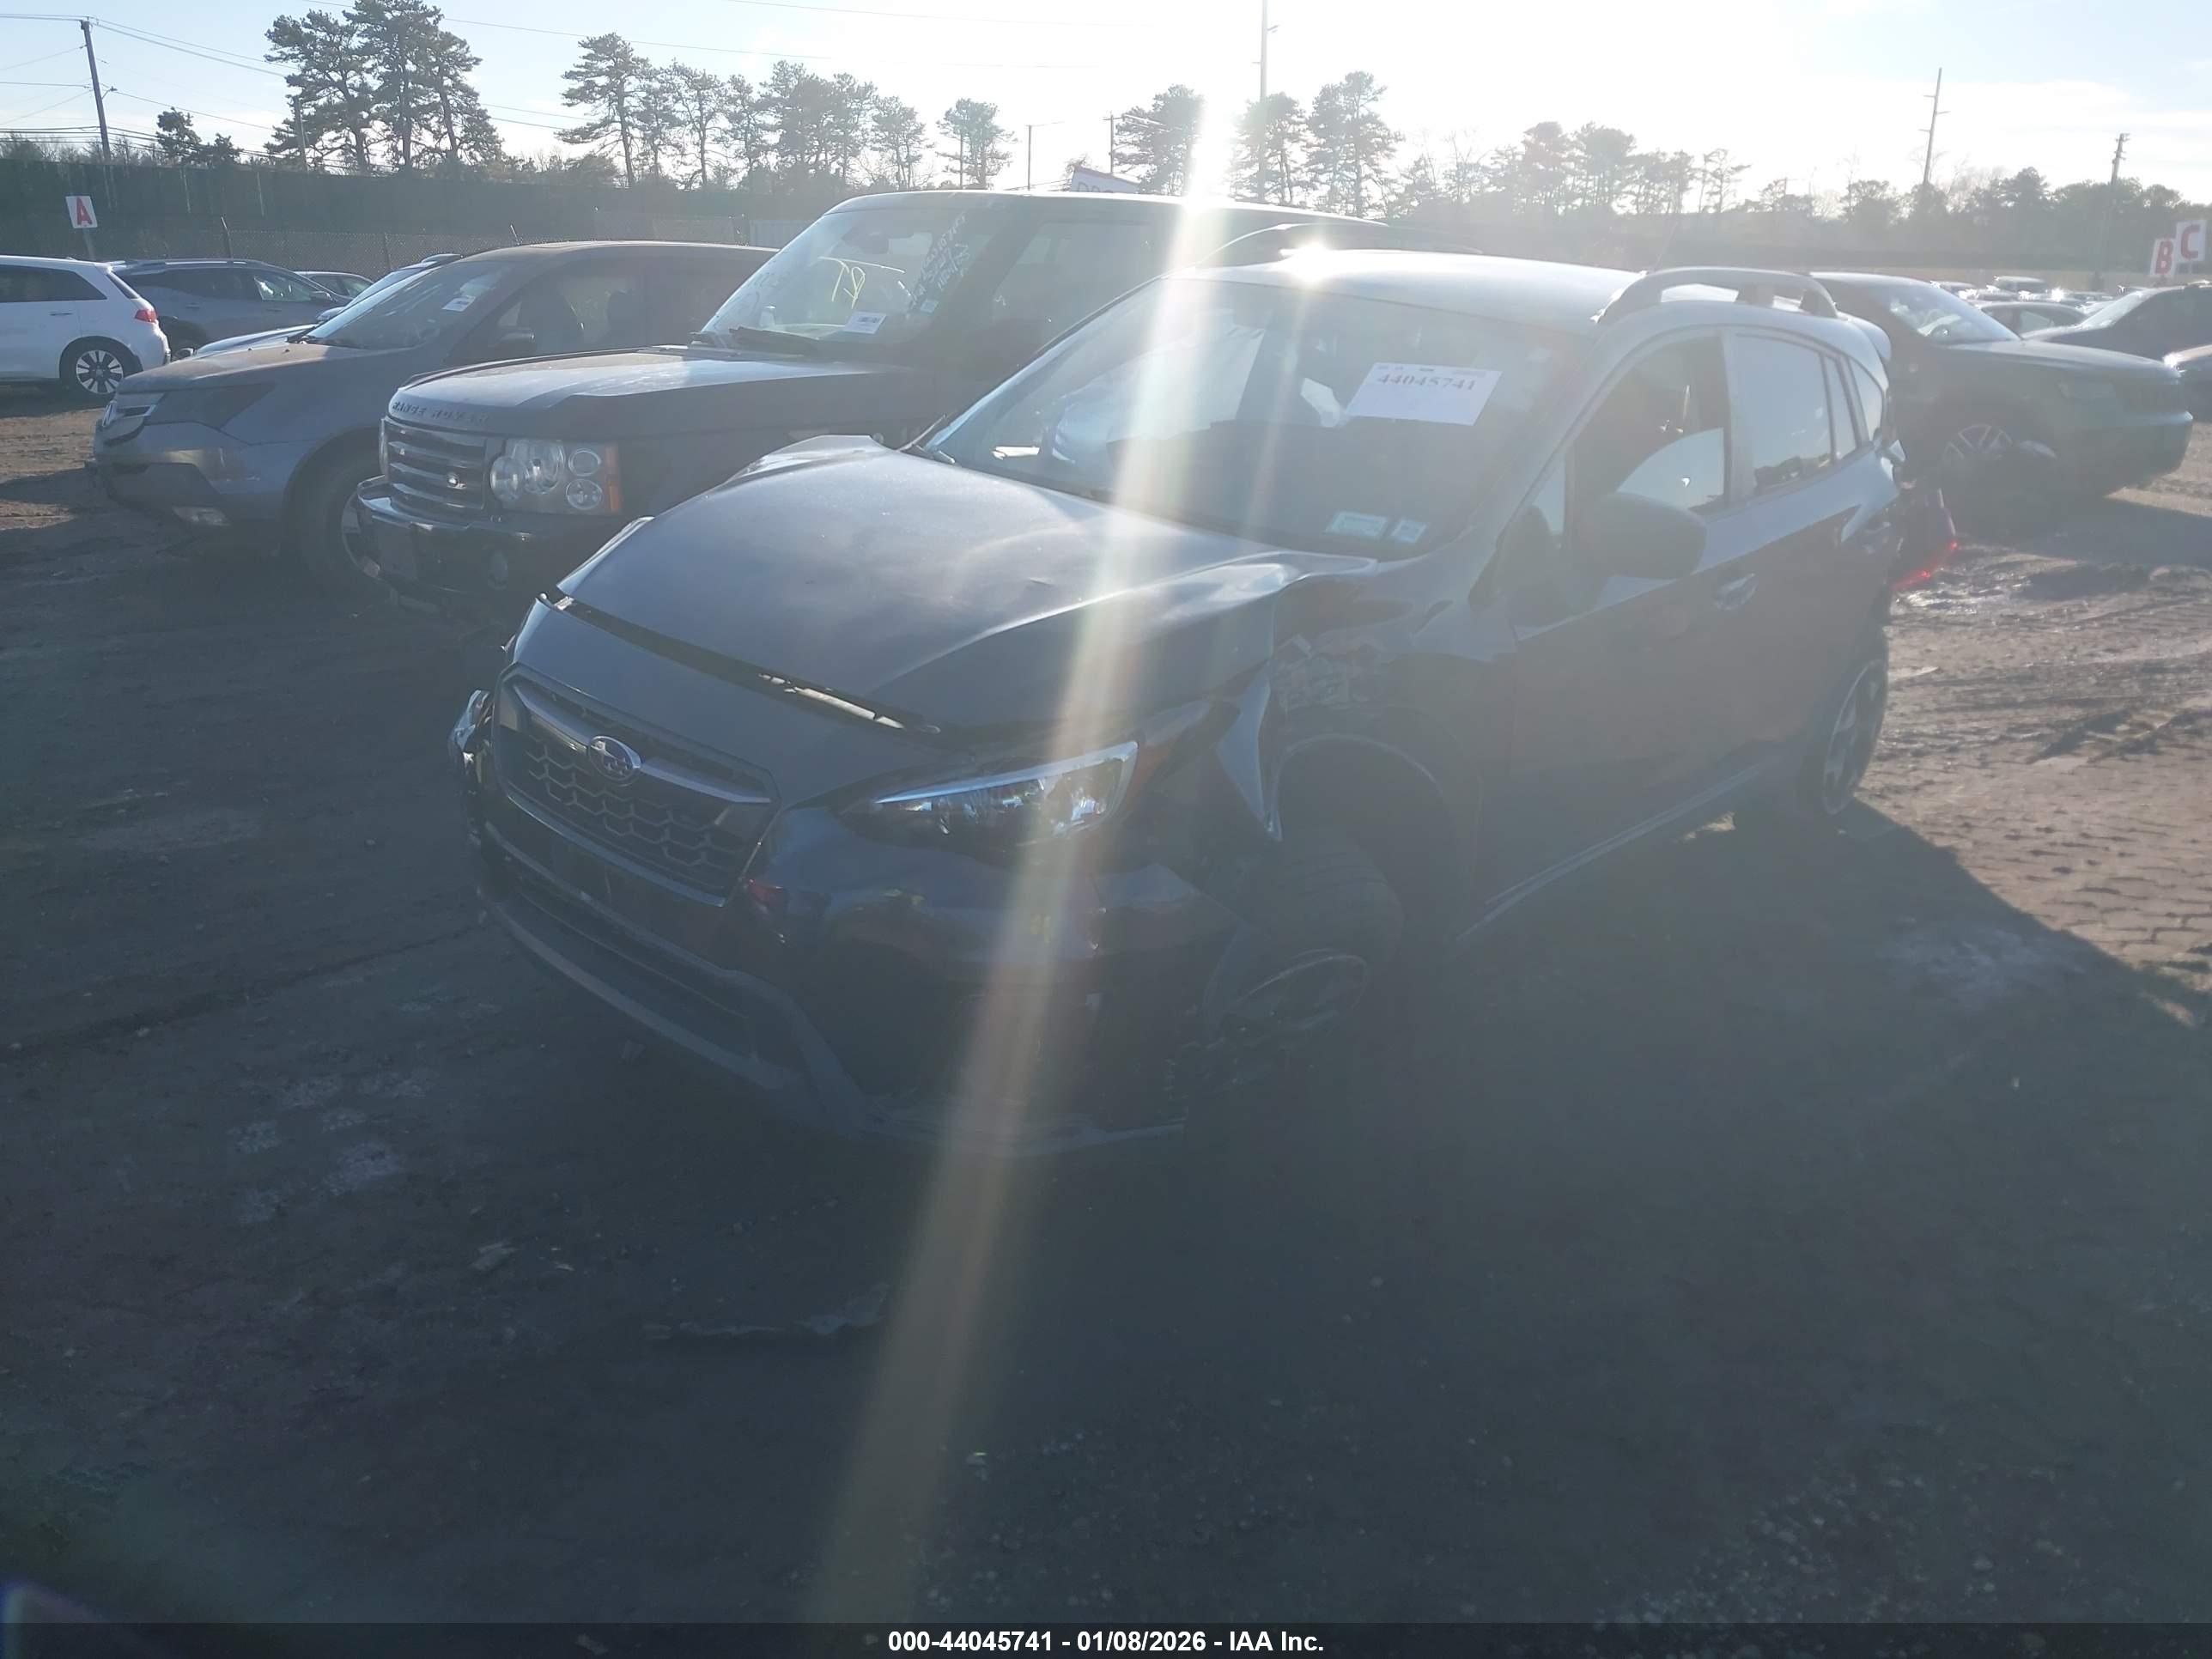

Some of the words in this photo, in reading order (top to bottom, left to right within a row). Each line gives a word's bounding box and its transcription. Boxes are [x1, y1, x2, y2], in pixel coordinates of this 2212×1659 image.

[76, 197, 93, 225] A
[2155, 240, 2173, 275] B
[2180, 224, 2201, 260] C
[1376, 373, 1477, 391] 44045741
